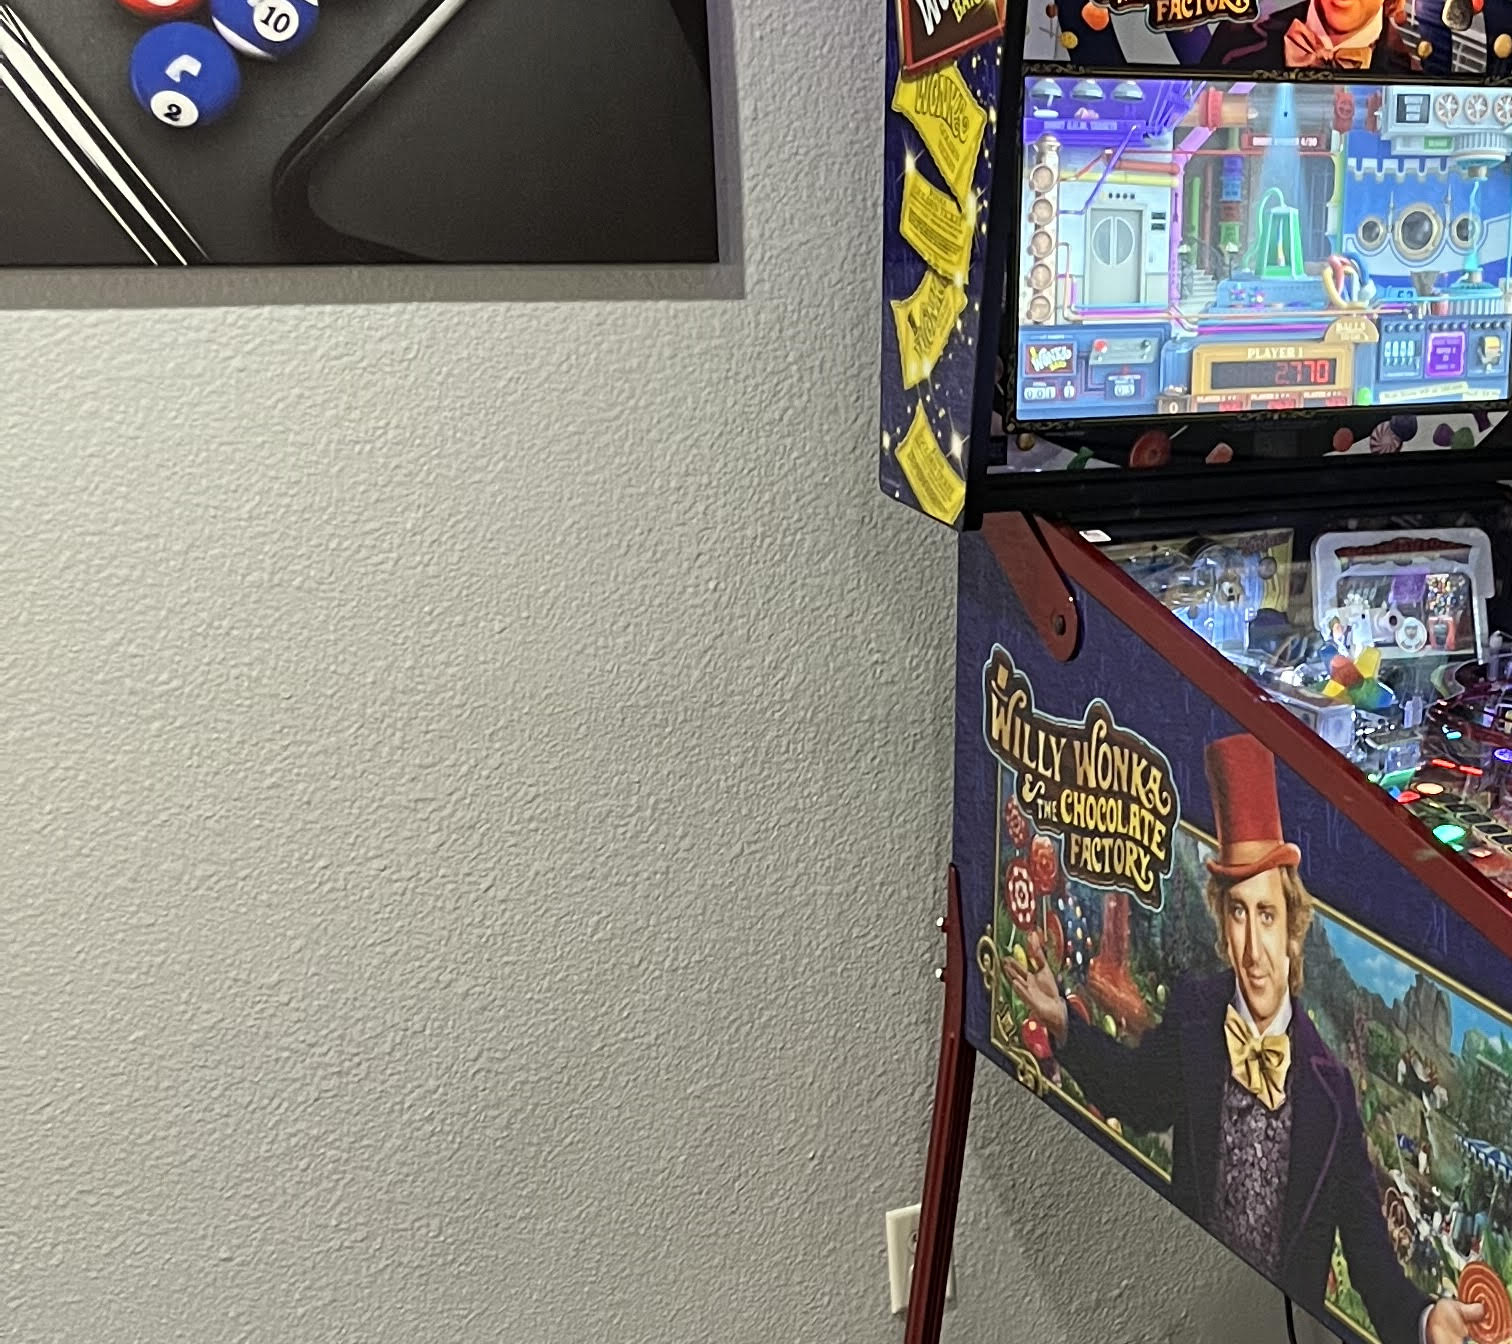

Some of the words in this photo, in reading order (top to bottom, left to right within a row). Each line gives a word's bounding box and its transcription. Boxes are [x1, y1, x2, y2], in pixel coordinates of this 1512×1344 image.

[259, 5, 291, 34] 10
[164, 103, 182, 121] 2
[1247, 347, 1295, 360] PLAYER
[1274, 359, 1330, 385] 2770
[991, 688, 1067, 783] WILLY
[1073, 719, 1172, 816] WONKA
[1021, 773, 1046, 804] &
[1037, 798, 1058, 823] THE
[1059, 788, 1167, 862] CHOCOLATE
[1069, 831, 1154, 892] FACTORY
